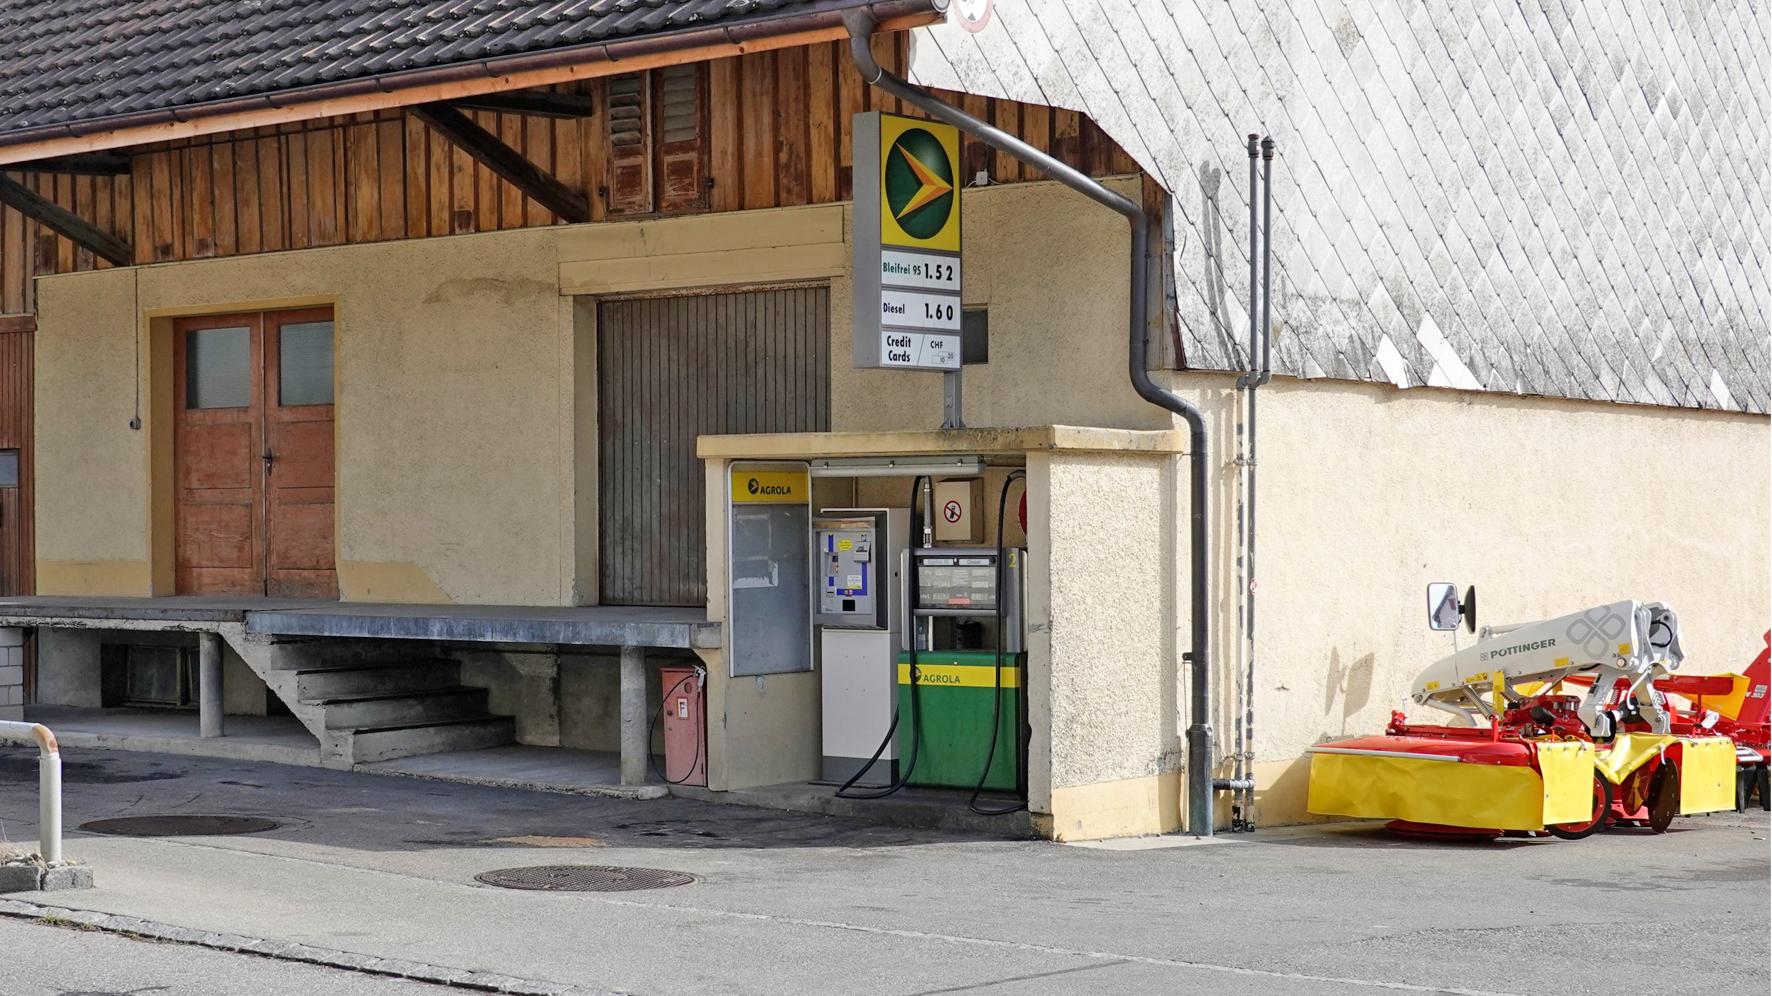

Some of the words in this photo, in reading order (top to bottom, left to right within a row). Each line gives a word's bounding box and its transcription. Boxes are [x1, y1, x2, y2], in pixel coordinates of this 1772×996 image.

[883, 262, 911, 275] Bleifrei
[912, 266, 921, 276] 95
[883, 302, 905, 314] Diesel
[886, 335, 911, 348] Credit
[930, 340, 944, 349] CHF
[888, 350, 911, 362] Cards
[760, 486, 792, 495] AGROLA
[1008, 552, 1017, 568] 2
[923, 674, 961, 684] AGROLA
